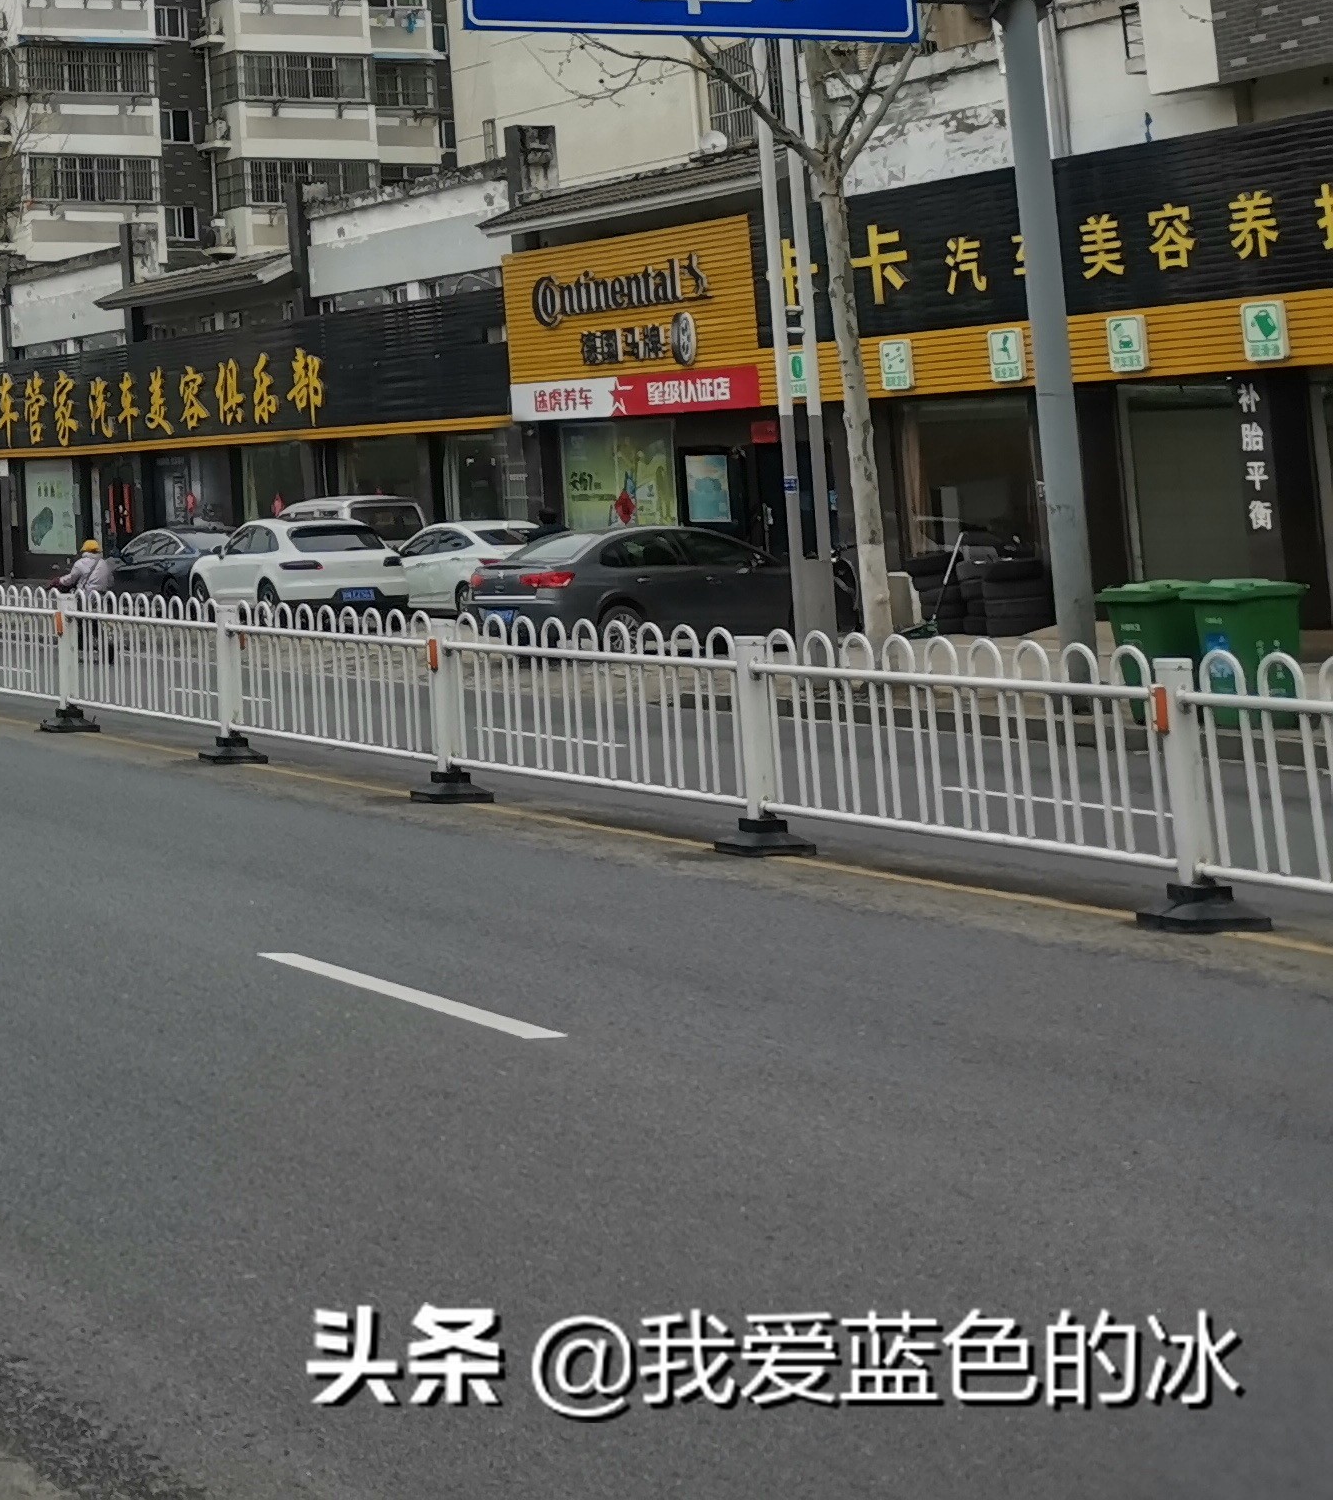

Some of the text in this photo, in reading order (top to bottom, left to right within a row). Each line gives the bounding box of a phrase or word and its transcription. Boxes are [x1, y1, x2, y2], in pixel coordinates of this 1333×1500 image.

[532, 258, 682, 328] Continental
[581, 324, 666, 366] 德国马牌
[534, 386, 594, 413] 途虎养车
[646, 376, 731, 406] 星级认证店
[1237, 382, 1273, 530] 补胎平衡
